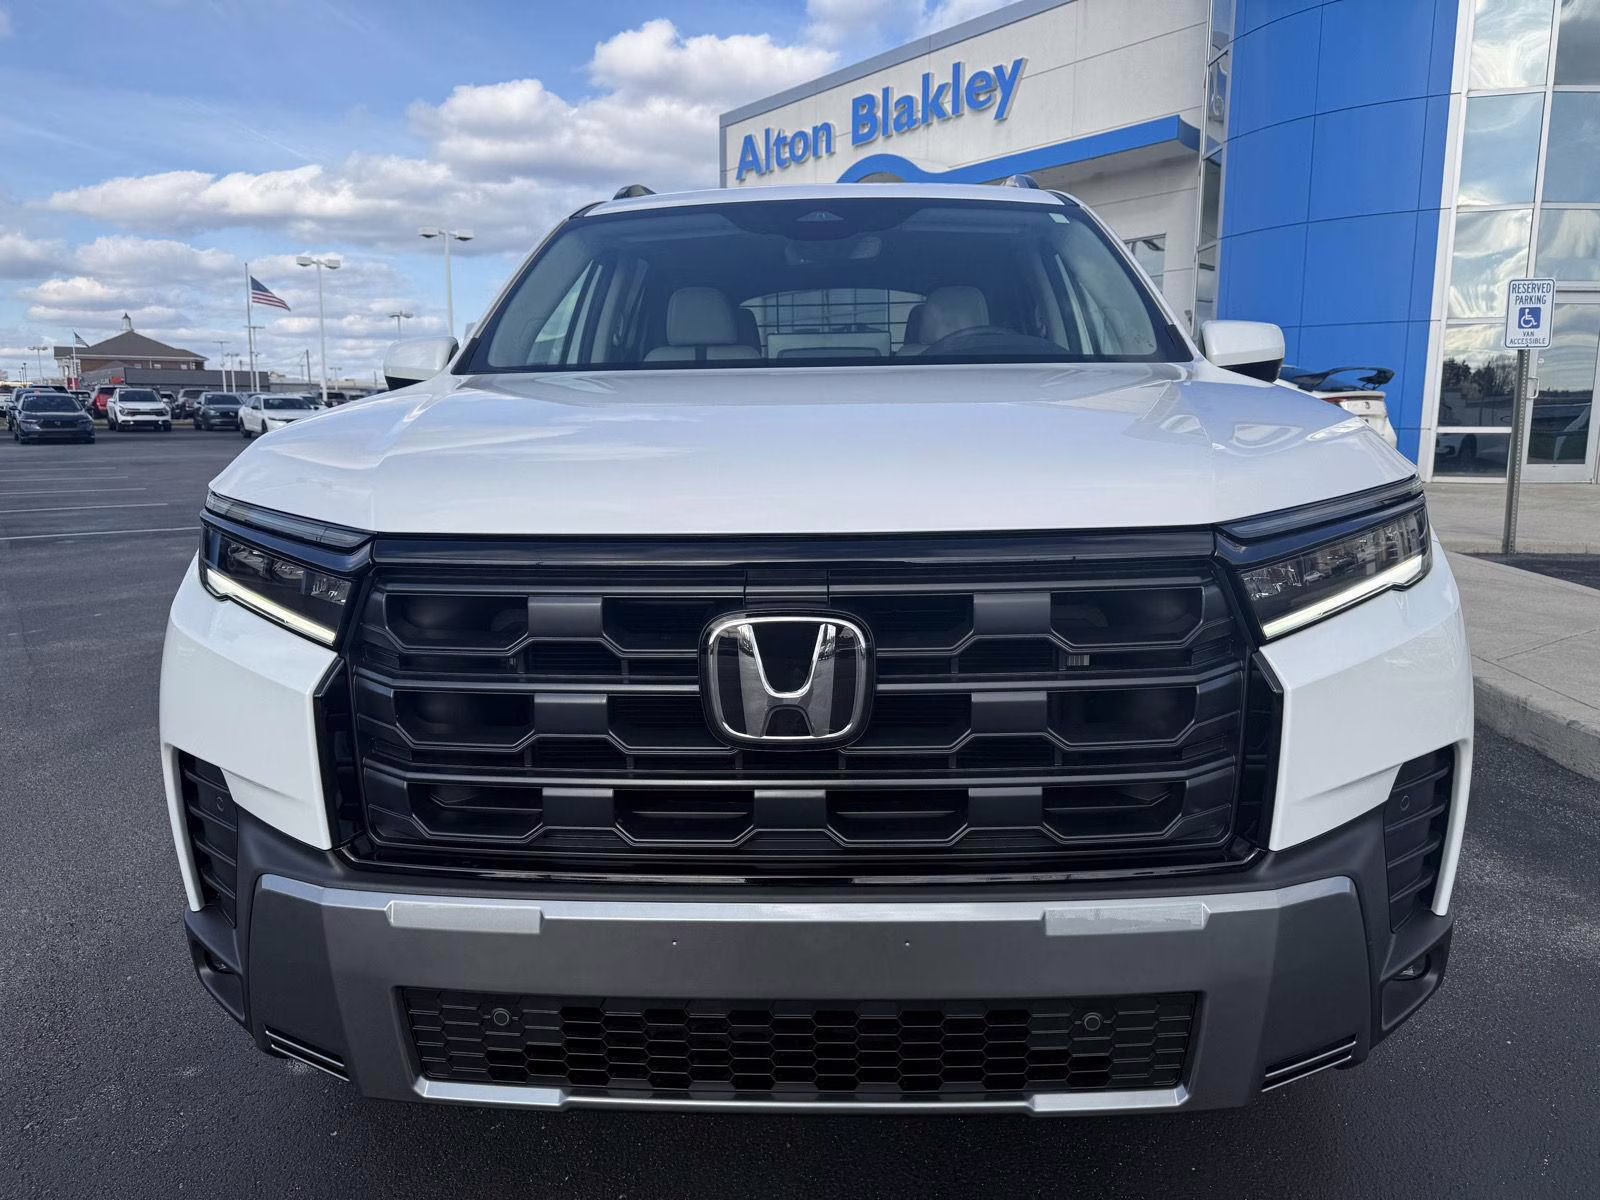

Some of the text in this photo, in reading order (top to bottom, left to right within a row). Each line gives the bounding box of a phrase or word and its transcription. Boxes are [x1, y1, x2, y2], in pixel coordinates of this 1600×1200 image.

[736, 57, 1027, 182] Alton Blakley
[1511, 283, 1552, 293] RESERVED
[1515, 295, 1547, 304] PARKING
[1509, 337, 1547, 345] ACCESSIBLE
